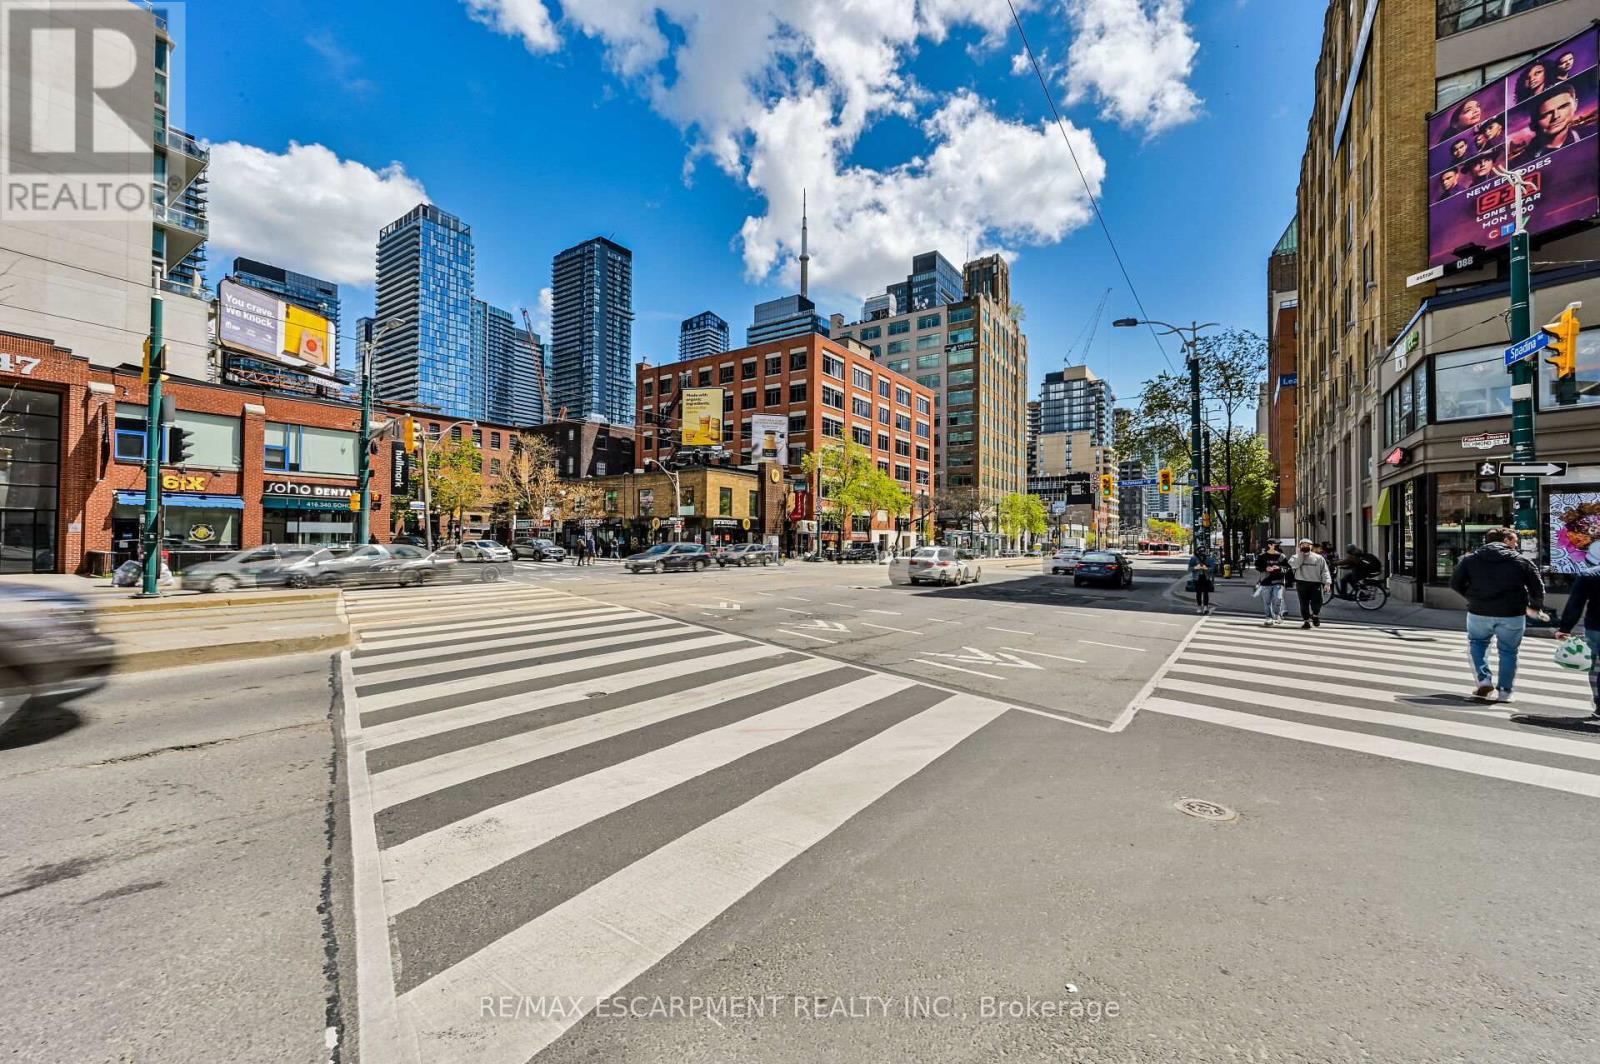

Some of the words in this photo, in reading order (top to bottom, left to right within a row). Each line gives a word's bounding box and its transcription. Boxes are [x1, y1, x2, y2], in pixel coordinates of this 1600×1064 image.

[1466, 183, 1491, 199] NEW
[1494, 157, 1552, 187] EPODES
[1476, 206, 1506, 222] LONE
[1482, 214, 1508, 230] MON
[1510, 204, 1535, 218] 900
[1456, 256, 1473, 269] 088
[225, 292, 245, 307] You
[246, 303, 276, 319] crave.
[225, 304, 242, 317] We
[243, 311, 276, 329] knock.
[1510, 338, 1537, 360] Spadina
[395, 450, 404, 487] hullmark
[265, 480, 311, 495] soho
